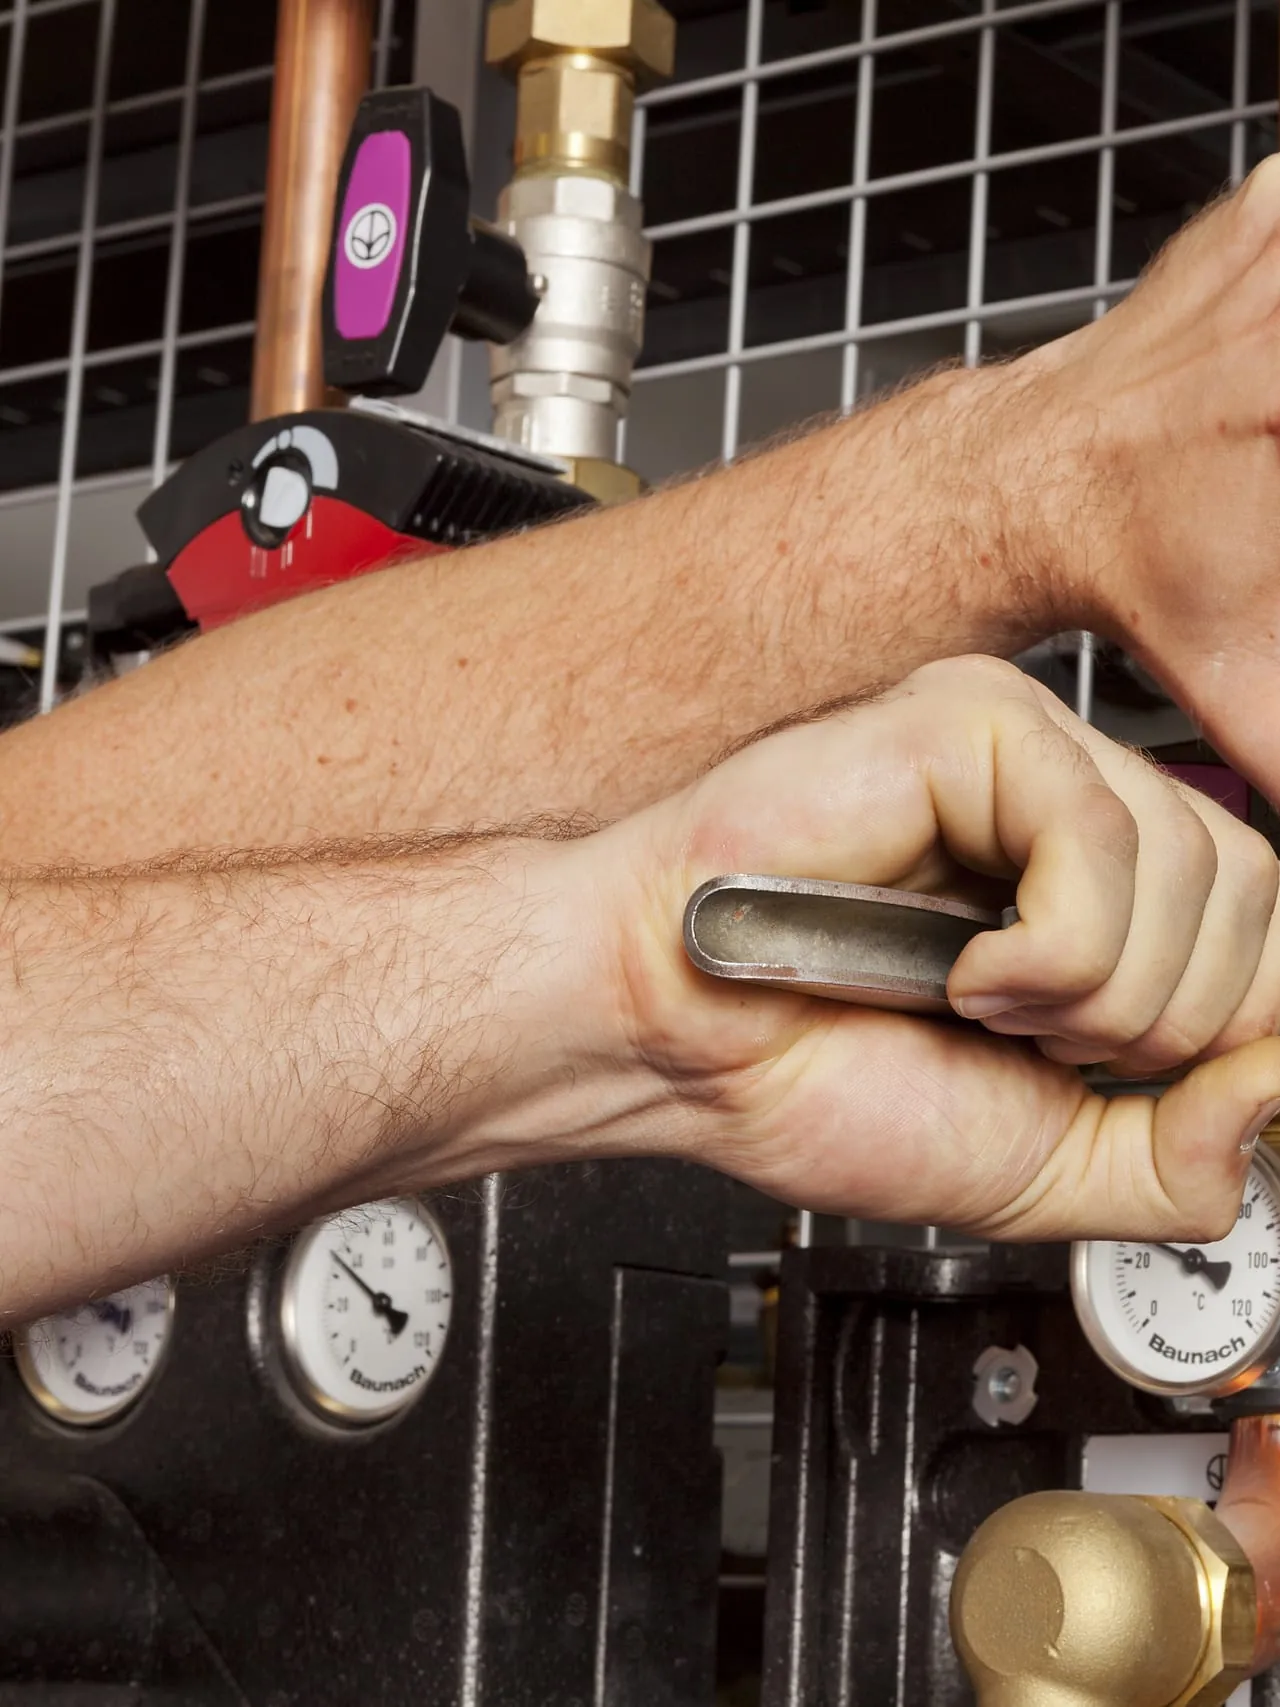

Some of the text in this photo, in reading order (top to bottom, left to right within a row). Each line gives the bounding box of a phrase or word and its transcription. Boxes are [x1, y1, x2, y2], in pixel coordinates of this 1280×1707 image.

[1135, 1252, 1150, 1269] 20
[1248, 1252, 1268, 1269] 100
[1150, 1300, 1157, 1316] 0
[1192, 1290, 1205, 1310] °C
[1231, 1300, 1252, 1316] 120
[1149, 1333, 1246, 1364] Baunach
[350, 1365, 427, 1392] Baunach
